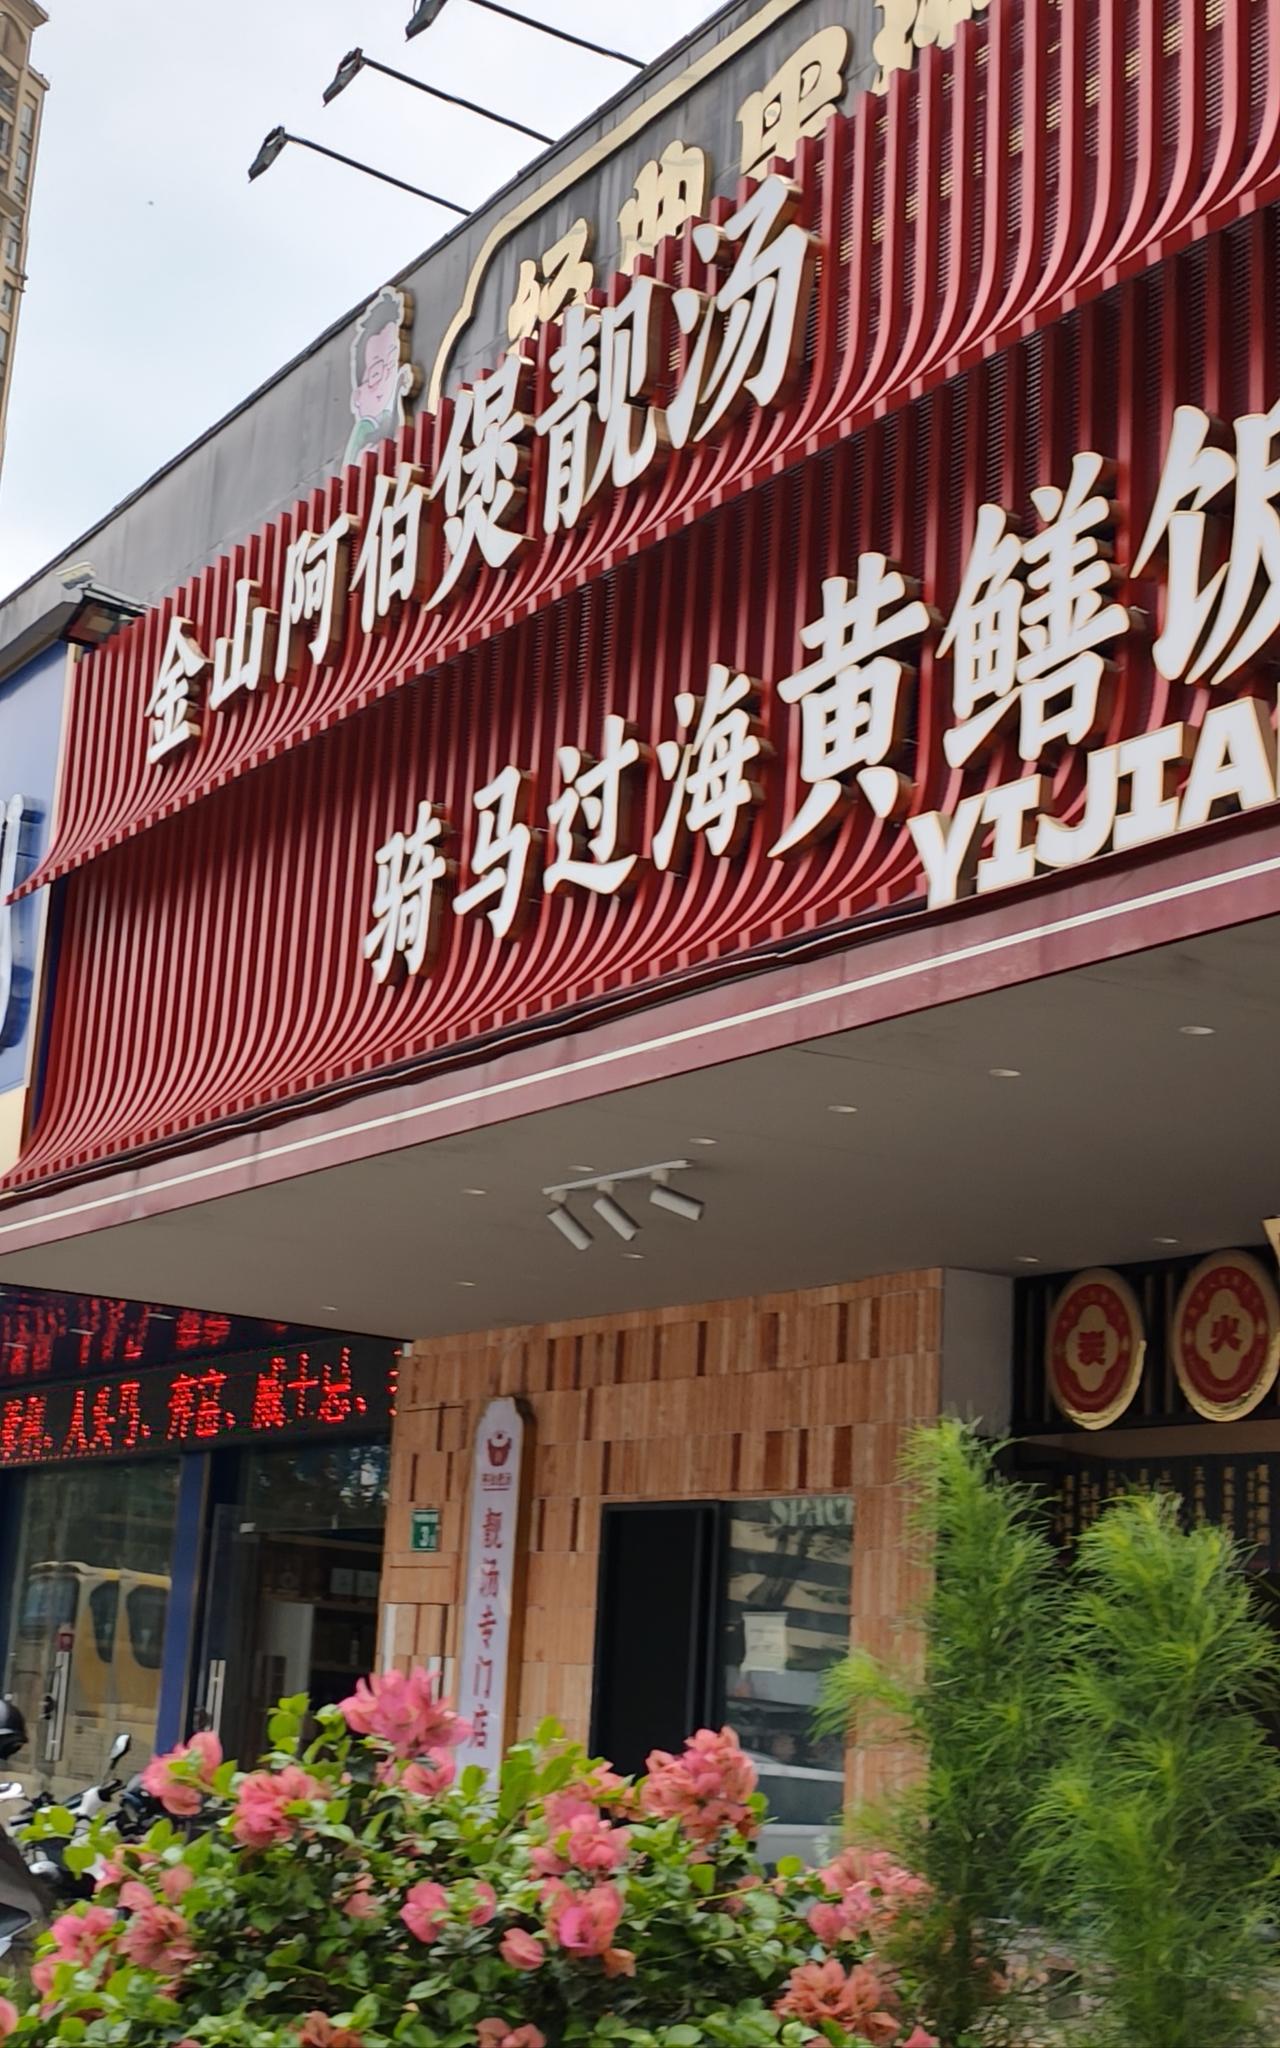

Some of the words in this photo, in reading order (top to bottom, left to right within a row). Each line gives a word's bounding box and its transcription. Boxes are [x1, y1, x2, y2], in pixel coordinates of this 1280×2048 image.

[145, 174, 810, 764] 金山阿伯煲靓汤
[905, 680, 1280, 909] YIJIA
